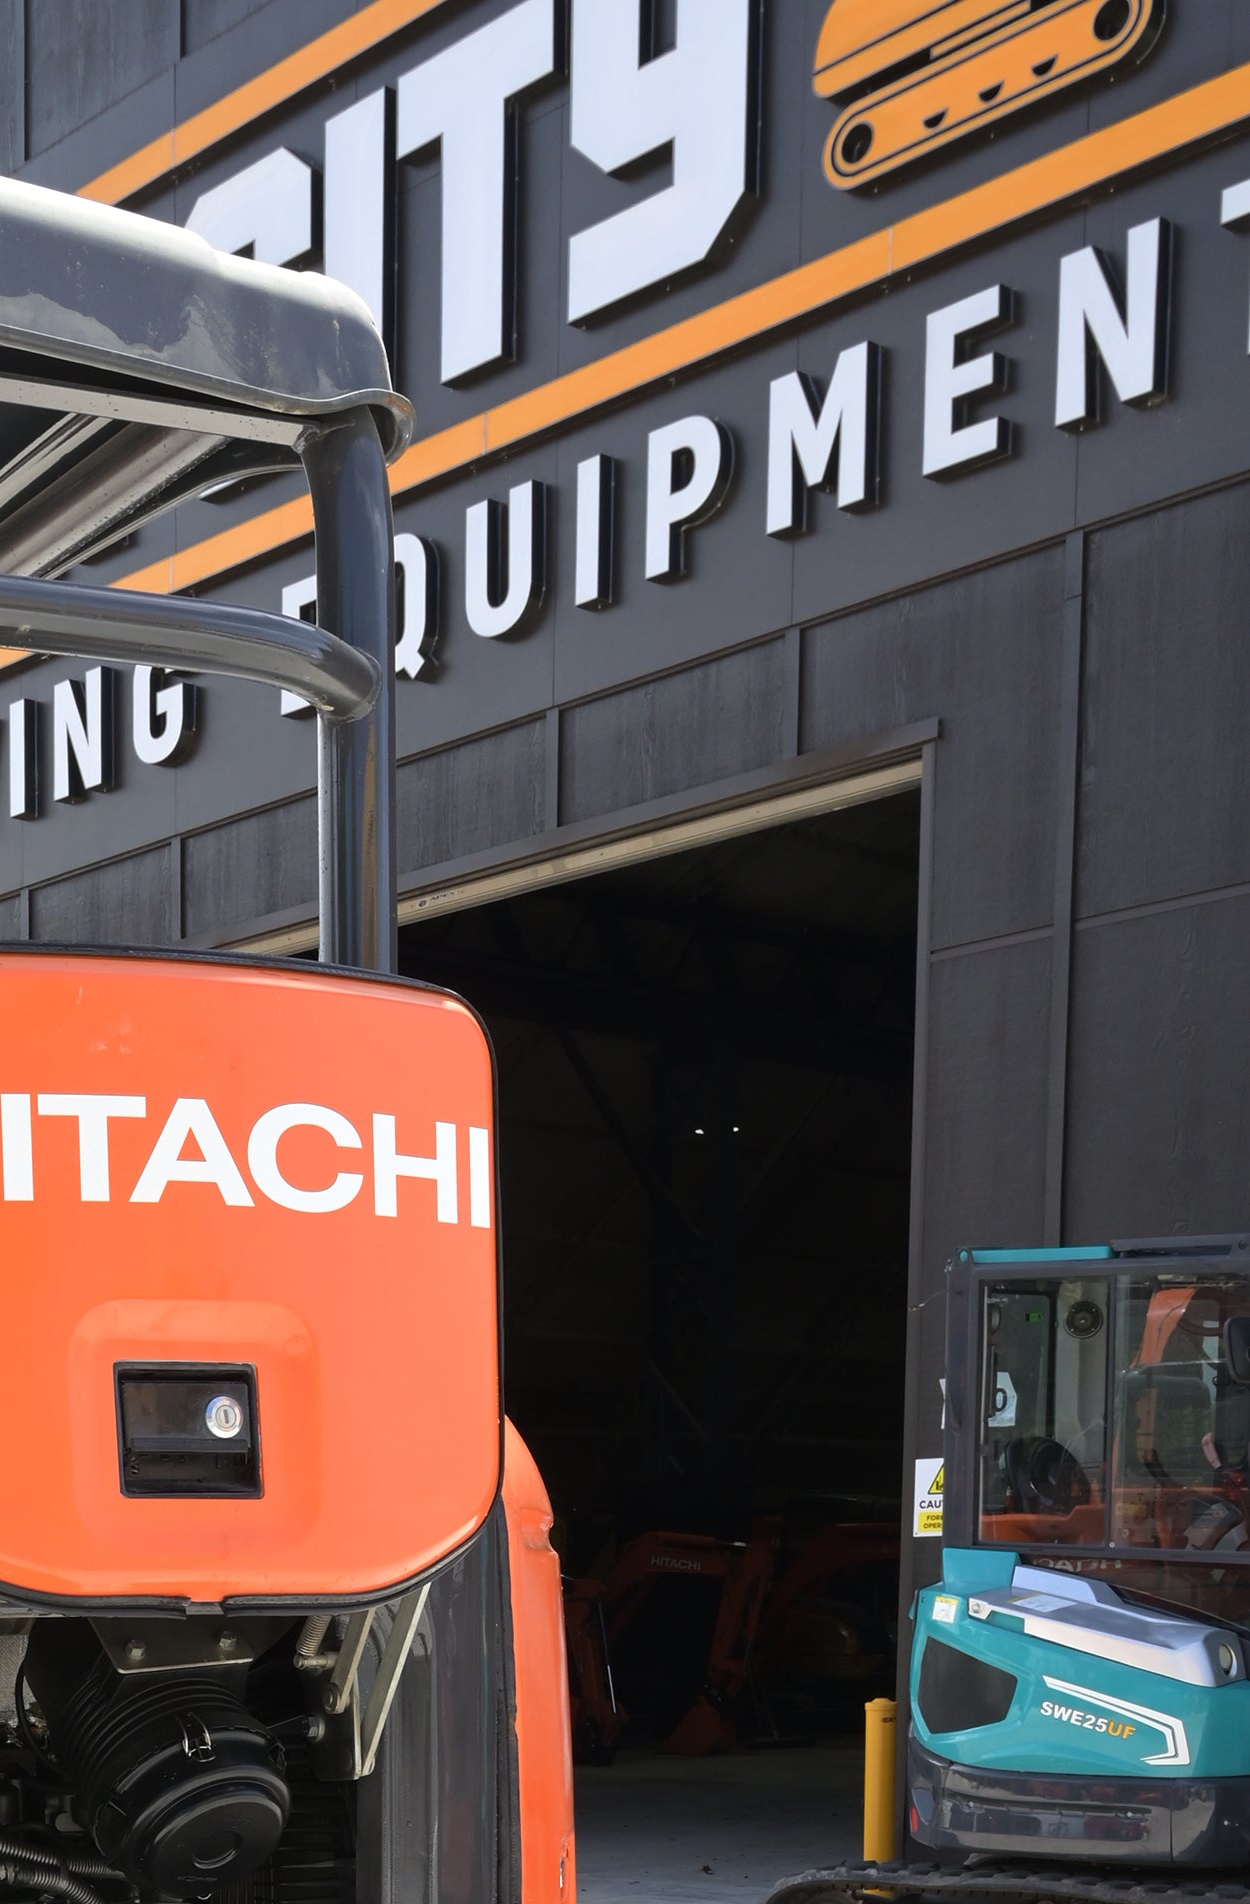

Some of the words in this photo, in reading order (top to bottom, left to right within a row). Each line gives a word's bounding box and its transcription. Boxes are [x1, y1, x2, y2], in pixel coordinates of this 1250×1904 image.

[919, 1500, 943, 1509] CAU
[649, 1555, 702, 1572] HITACHI
[1040, 1701, 1137, 1739] SWE25UF
